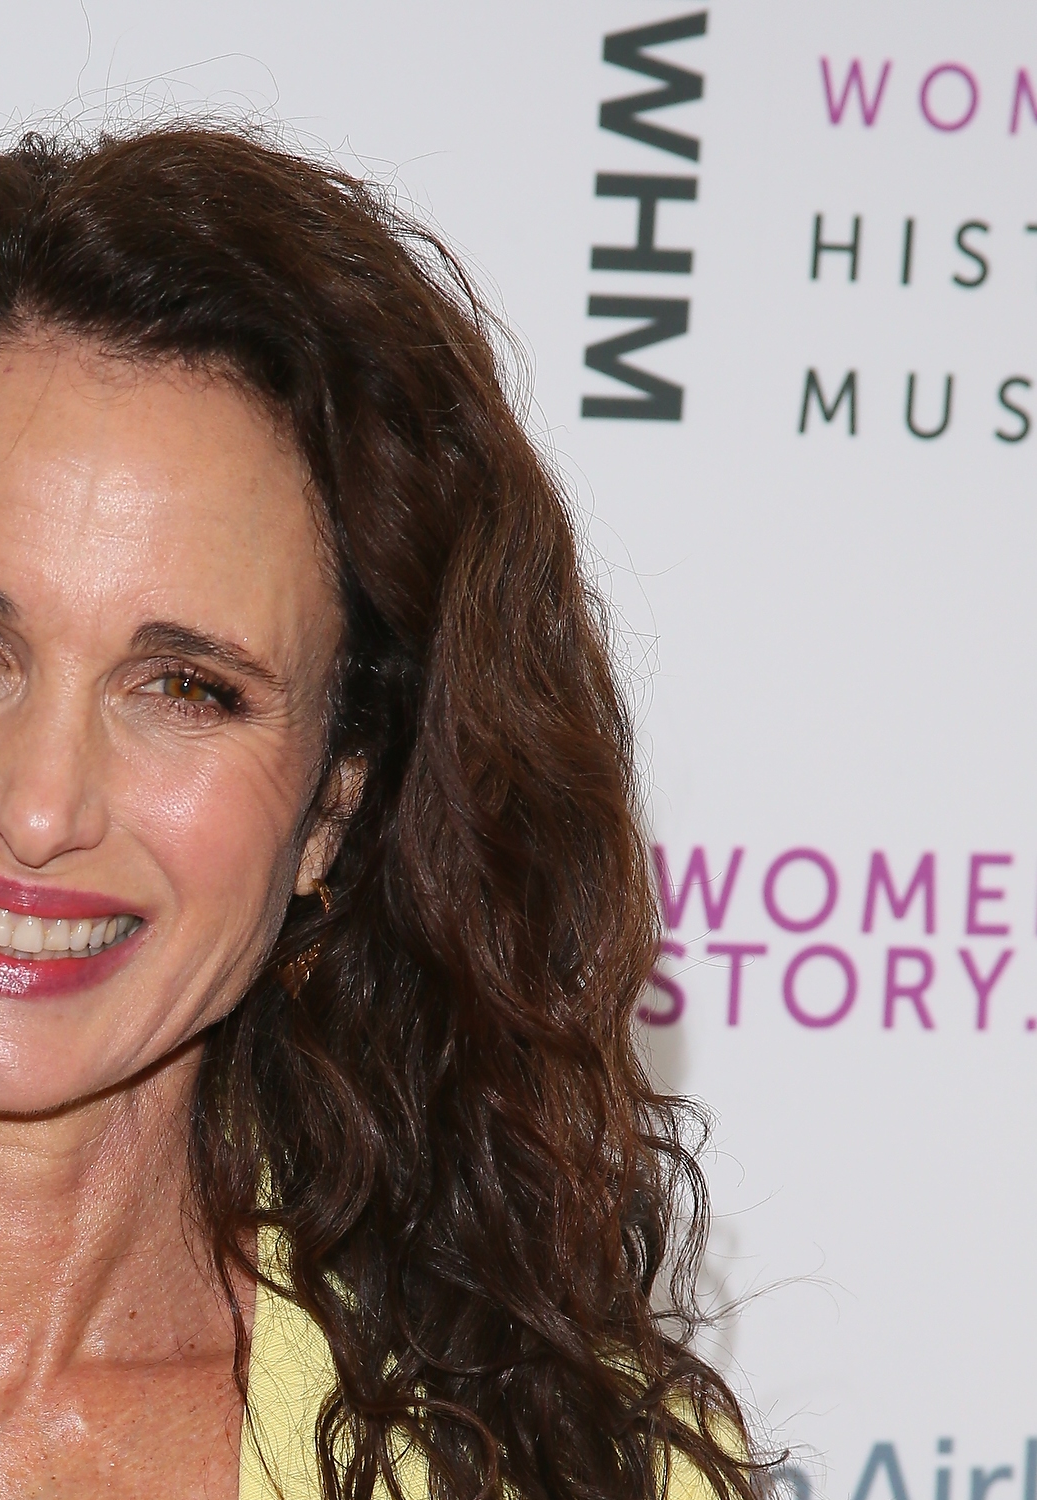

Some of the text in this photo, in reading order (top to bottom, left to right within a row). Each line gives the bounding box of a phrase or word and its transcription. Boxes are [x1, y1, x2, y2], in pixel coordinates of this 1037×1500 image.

[580, 9, 707, 423] WHM
[810, 213, 1037, 289] HIS
[798, 368, 1032, 445] MUS
[654, 846, 1037, 937] WOME
